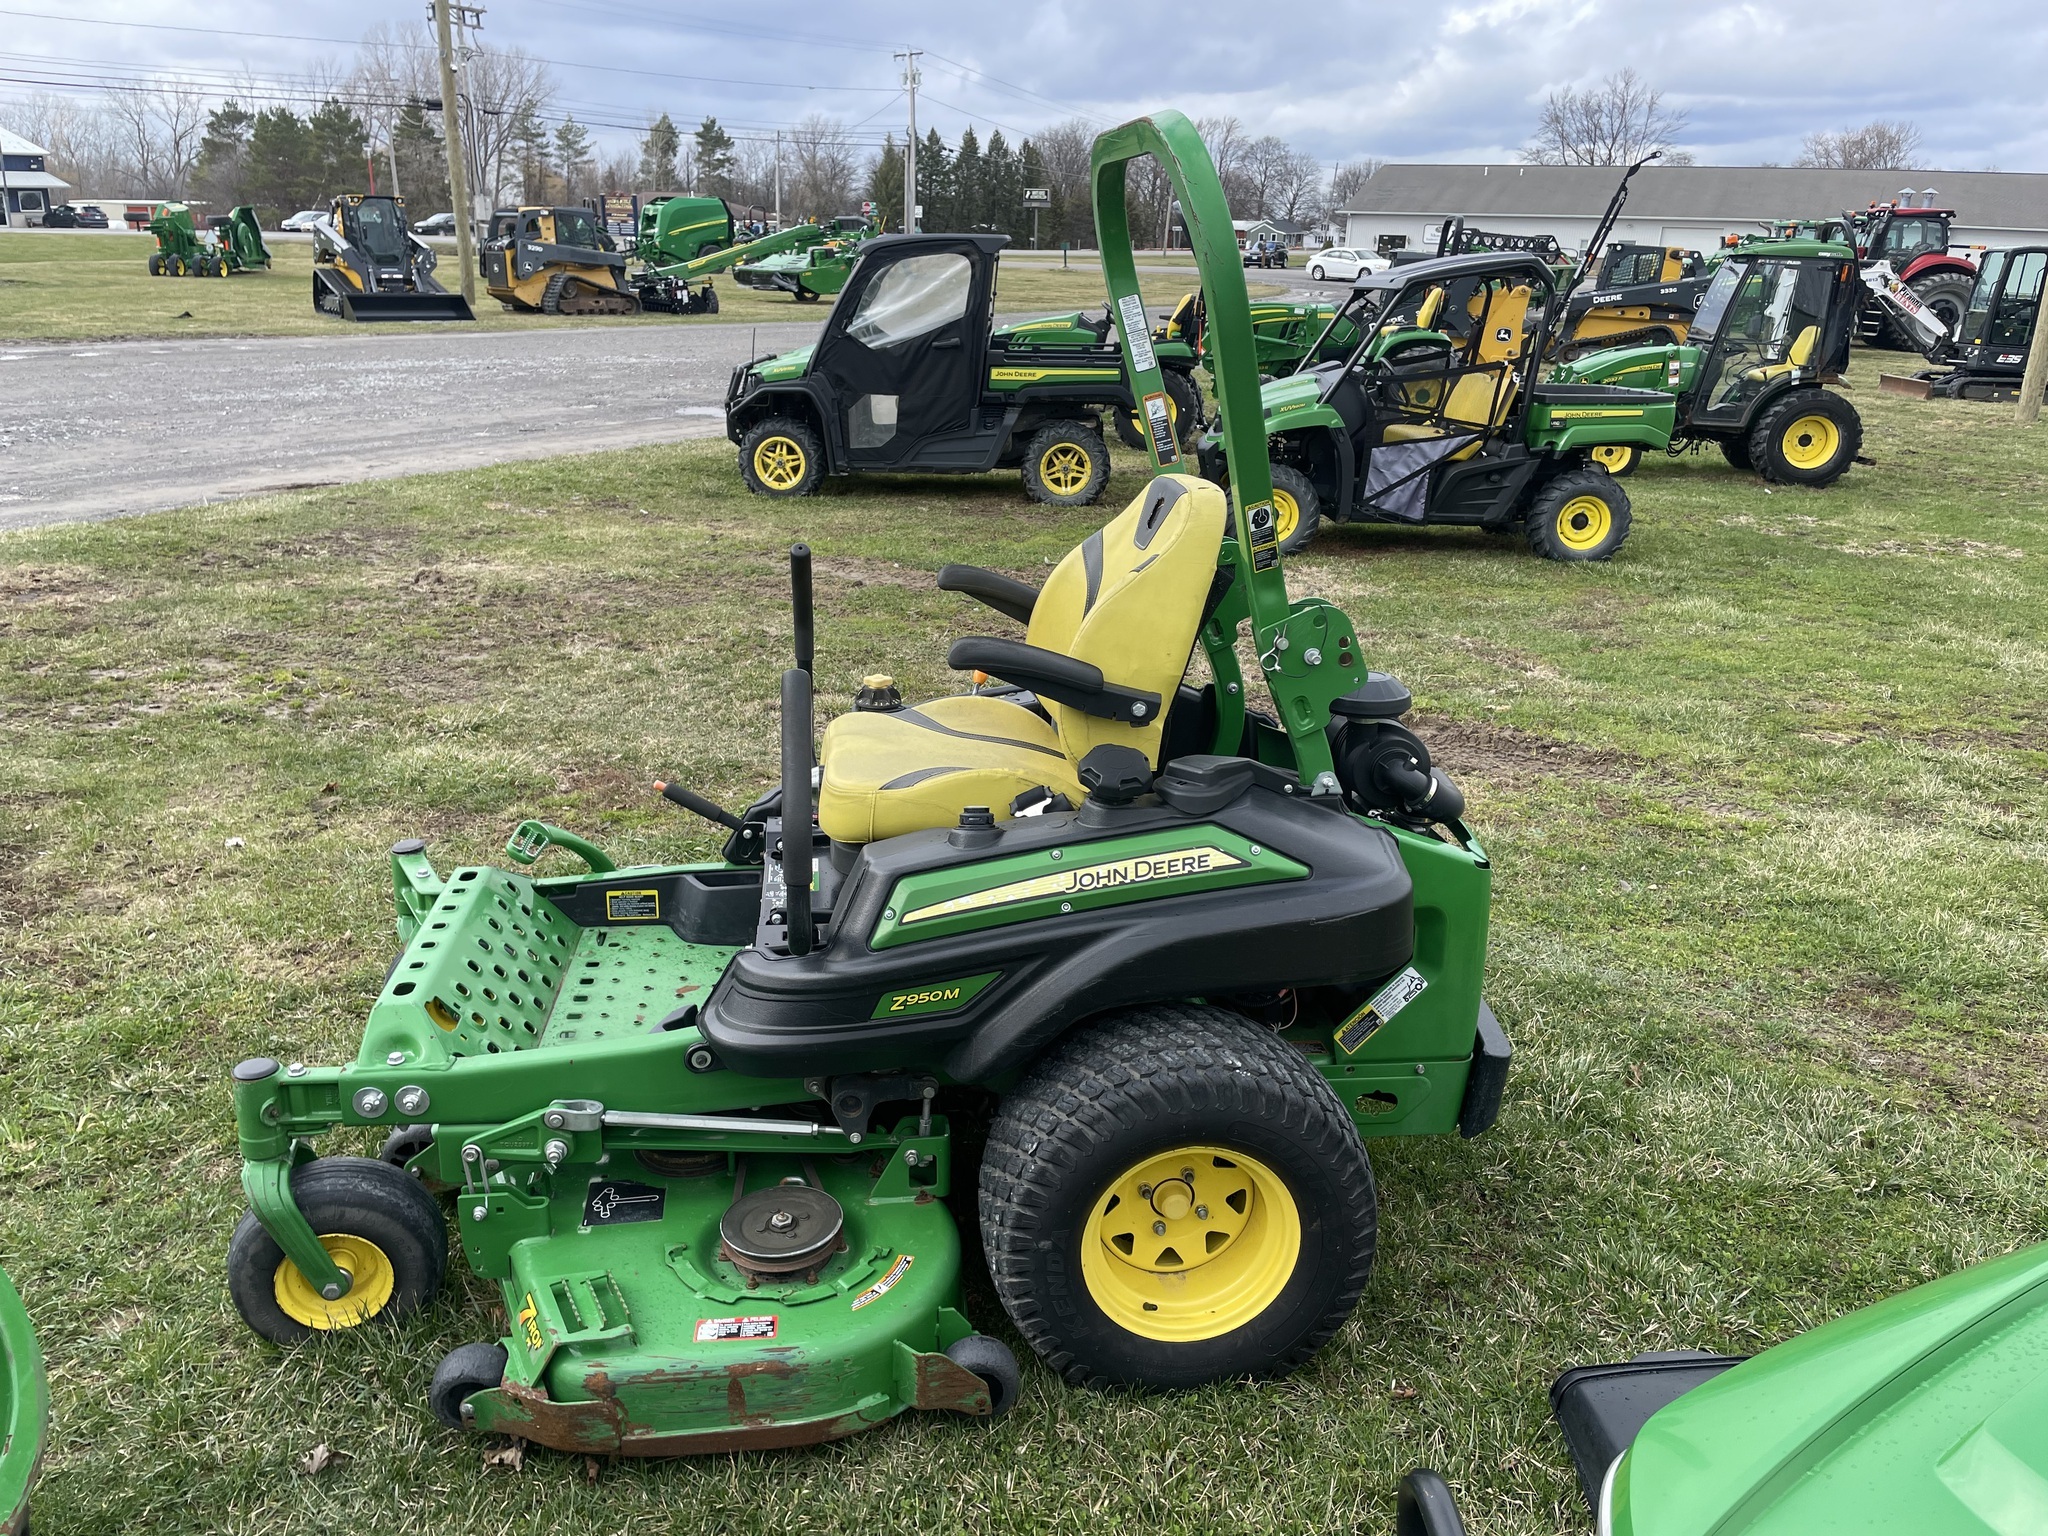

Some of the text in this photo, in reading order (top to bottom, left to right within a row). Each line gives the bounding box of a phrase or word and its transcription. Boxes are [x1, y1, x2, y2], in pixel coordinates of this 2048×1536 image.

[1593, 294, 1622, 304] DEERE
[1896, 293, 1918, 314] RENTS
[1996, 354, 2023, 364] E35
[1065, 854, 1211, 891] JOHN DEERE
[890, 988, 960, 1011] Z950M
